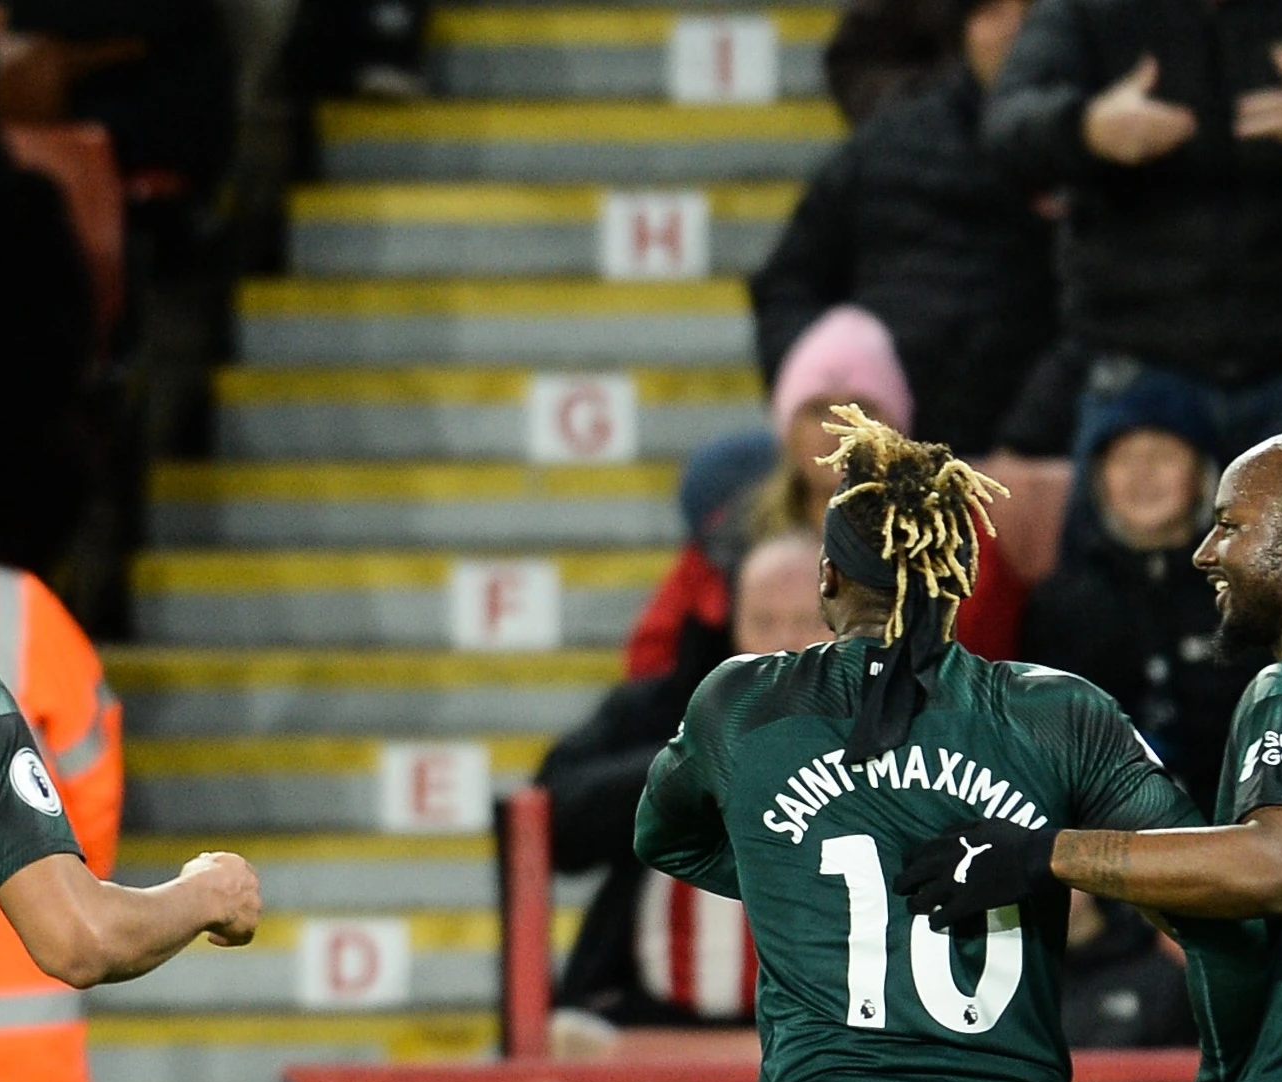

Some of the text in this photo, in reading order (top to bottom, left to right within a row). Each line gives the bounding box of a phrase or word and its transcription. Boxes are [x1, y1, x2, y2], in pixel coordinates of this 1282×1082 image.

[630, 205, 686, 266] H
[556, 381, 615, 456] G
[482, 566, 527, 638] F
[410, 750, 460, 826] E
[327, 922, 383, 998] D
[820, 834, 1024, 1034] 10
